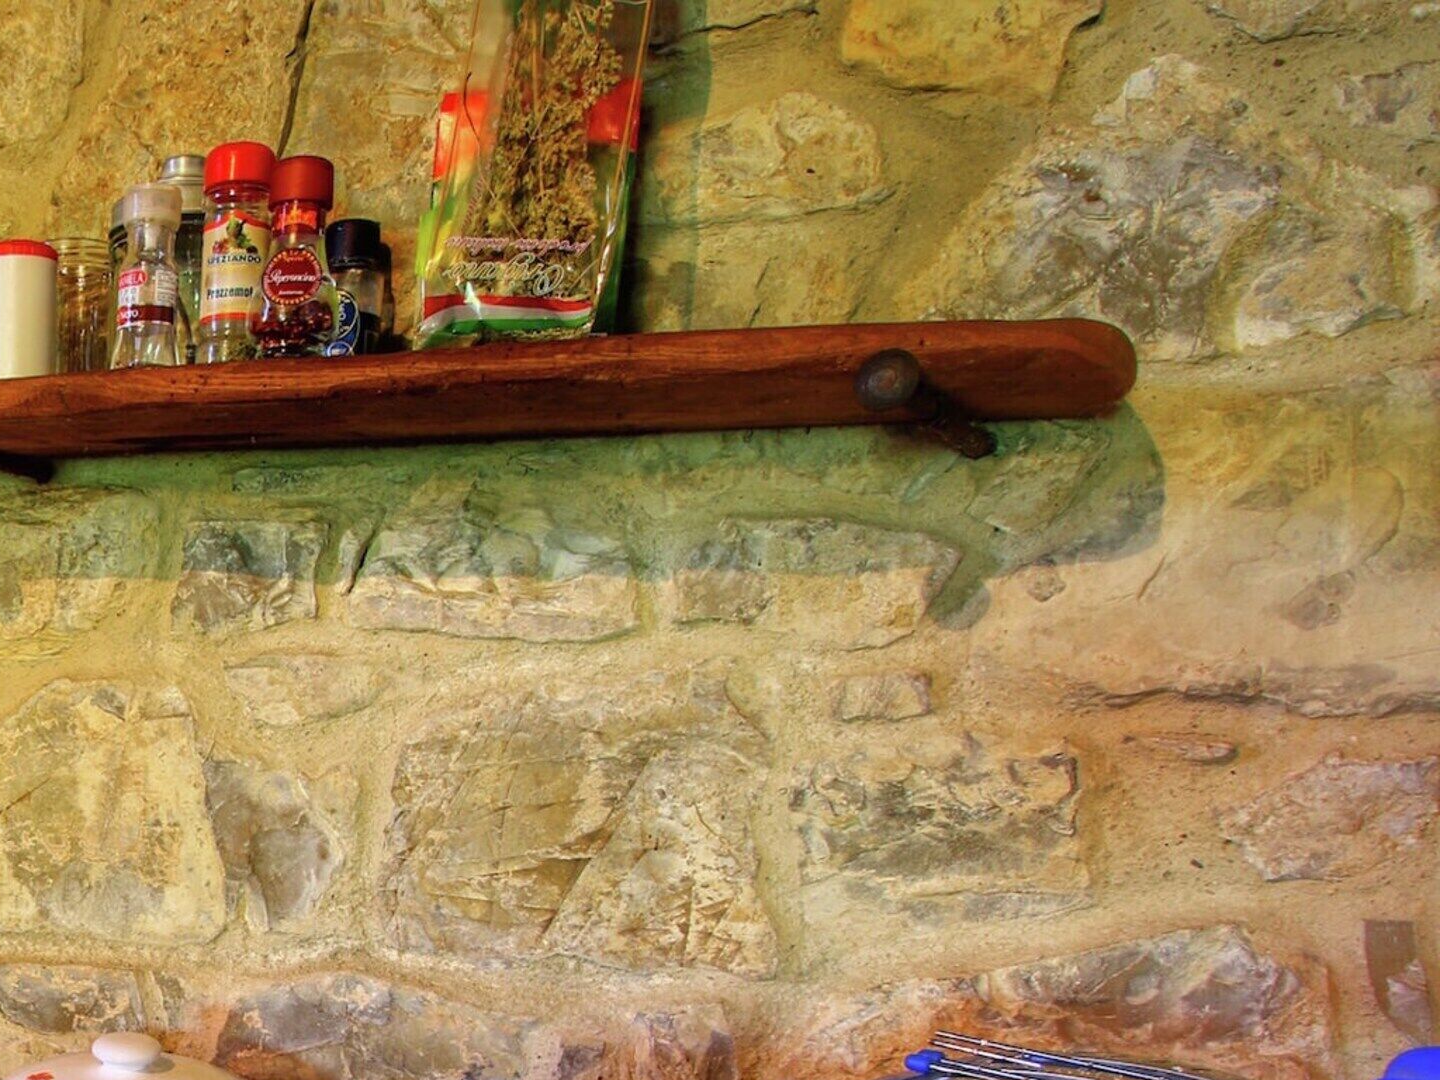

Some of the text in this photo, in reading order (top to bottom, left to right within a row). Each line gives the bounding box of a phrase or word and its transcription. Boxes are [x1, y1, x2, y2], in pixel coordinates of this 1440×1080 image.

[207, 254, 261, 265] SPEZIANDO
[270, 269, 316, 286] Peperoncino
[442, 252, 565, 296] Origano
[206, 286, 254, 299] Prezzemol
